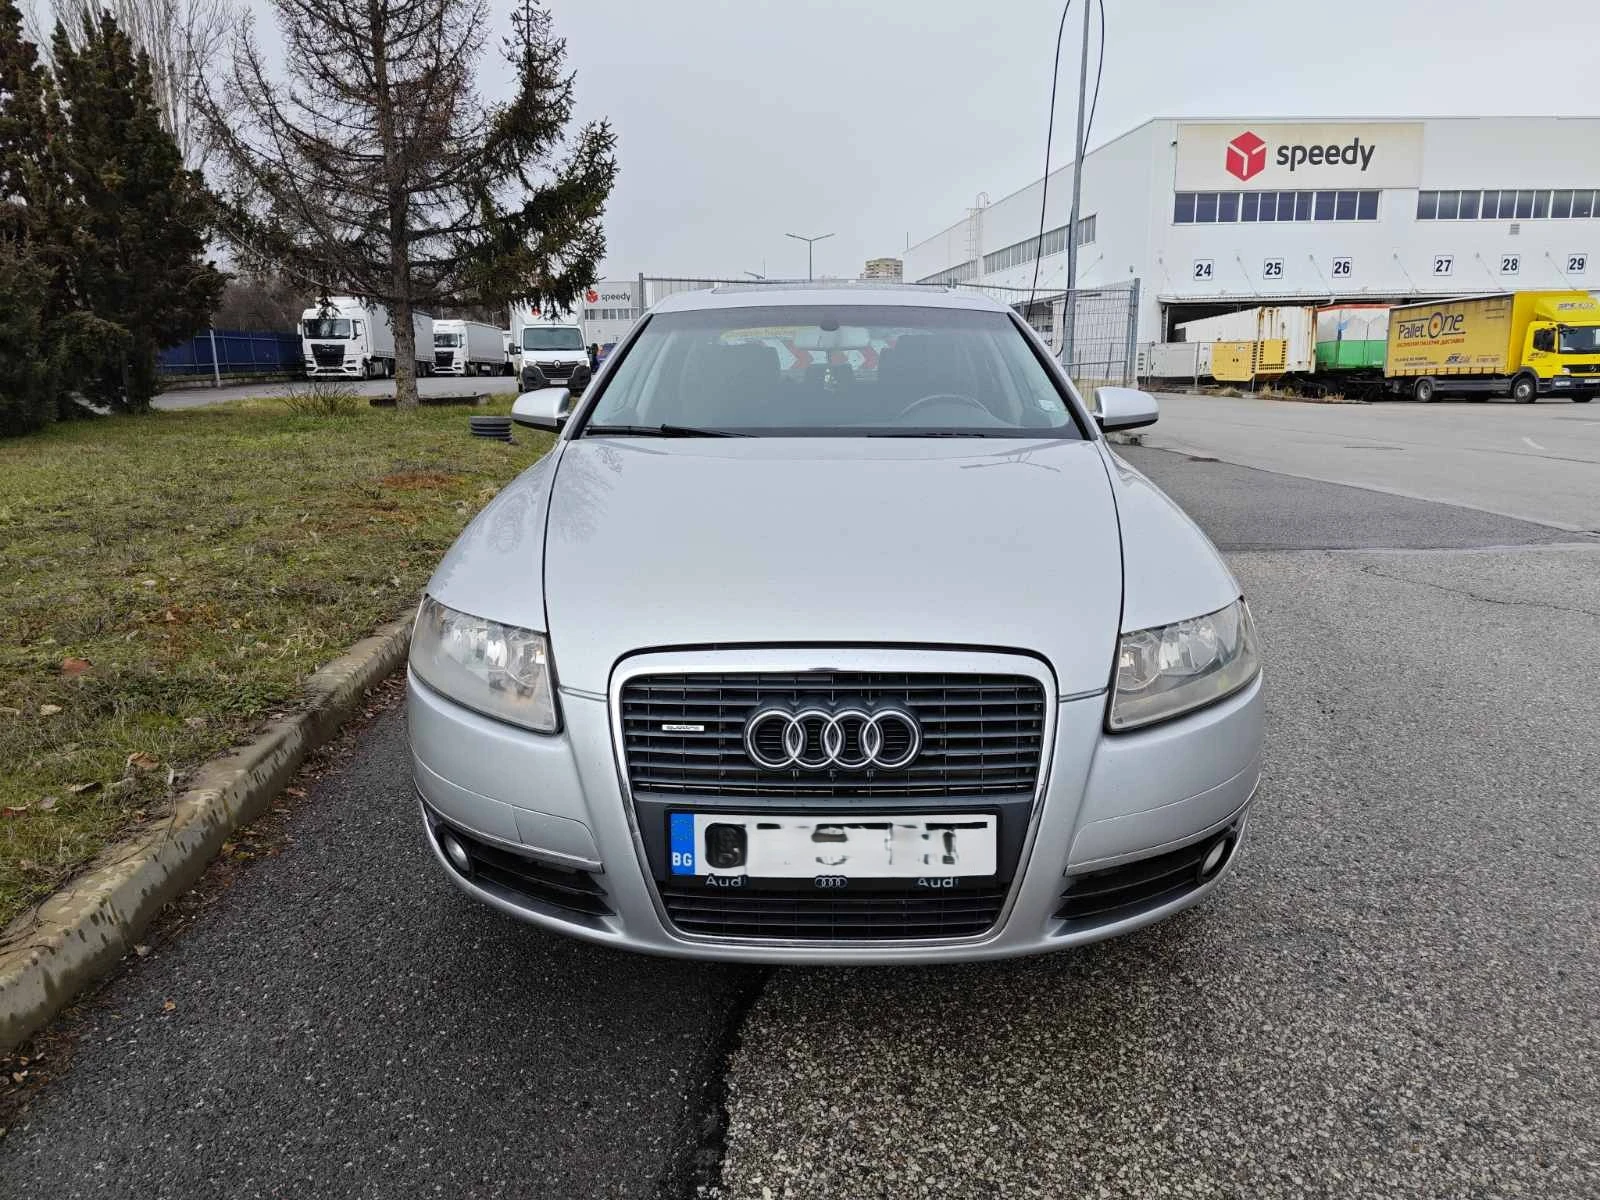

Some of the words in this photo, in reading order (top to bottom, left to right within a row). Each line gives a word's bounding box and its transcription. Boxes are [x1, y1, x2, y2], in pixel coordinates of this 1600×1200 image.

[1276, 136, 1375, 172] speedy
[1195, 263, 1212, 277] 24
[1265, 262, 1282, 276] 25
[1334, 261, 1350, 274] 26
[1435, 259, 1452, 273] 27
[1502, 258, 1518, 271] 28
[1569, 257, 1585, 271] 29
[601, 292, 631, 303] speedy
[1428, 311, 1464, 339] One
[672, 852, 693, 866] BG
